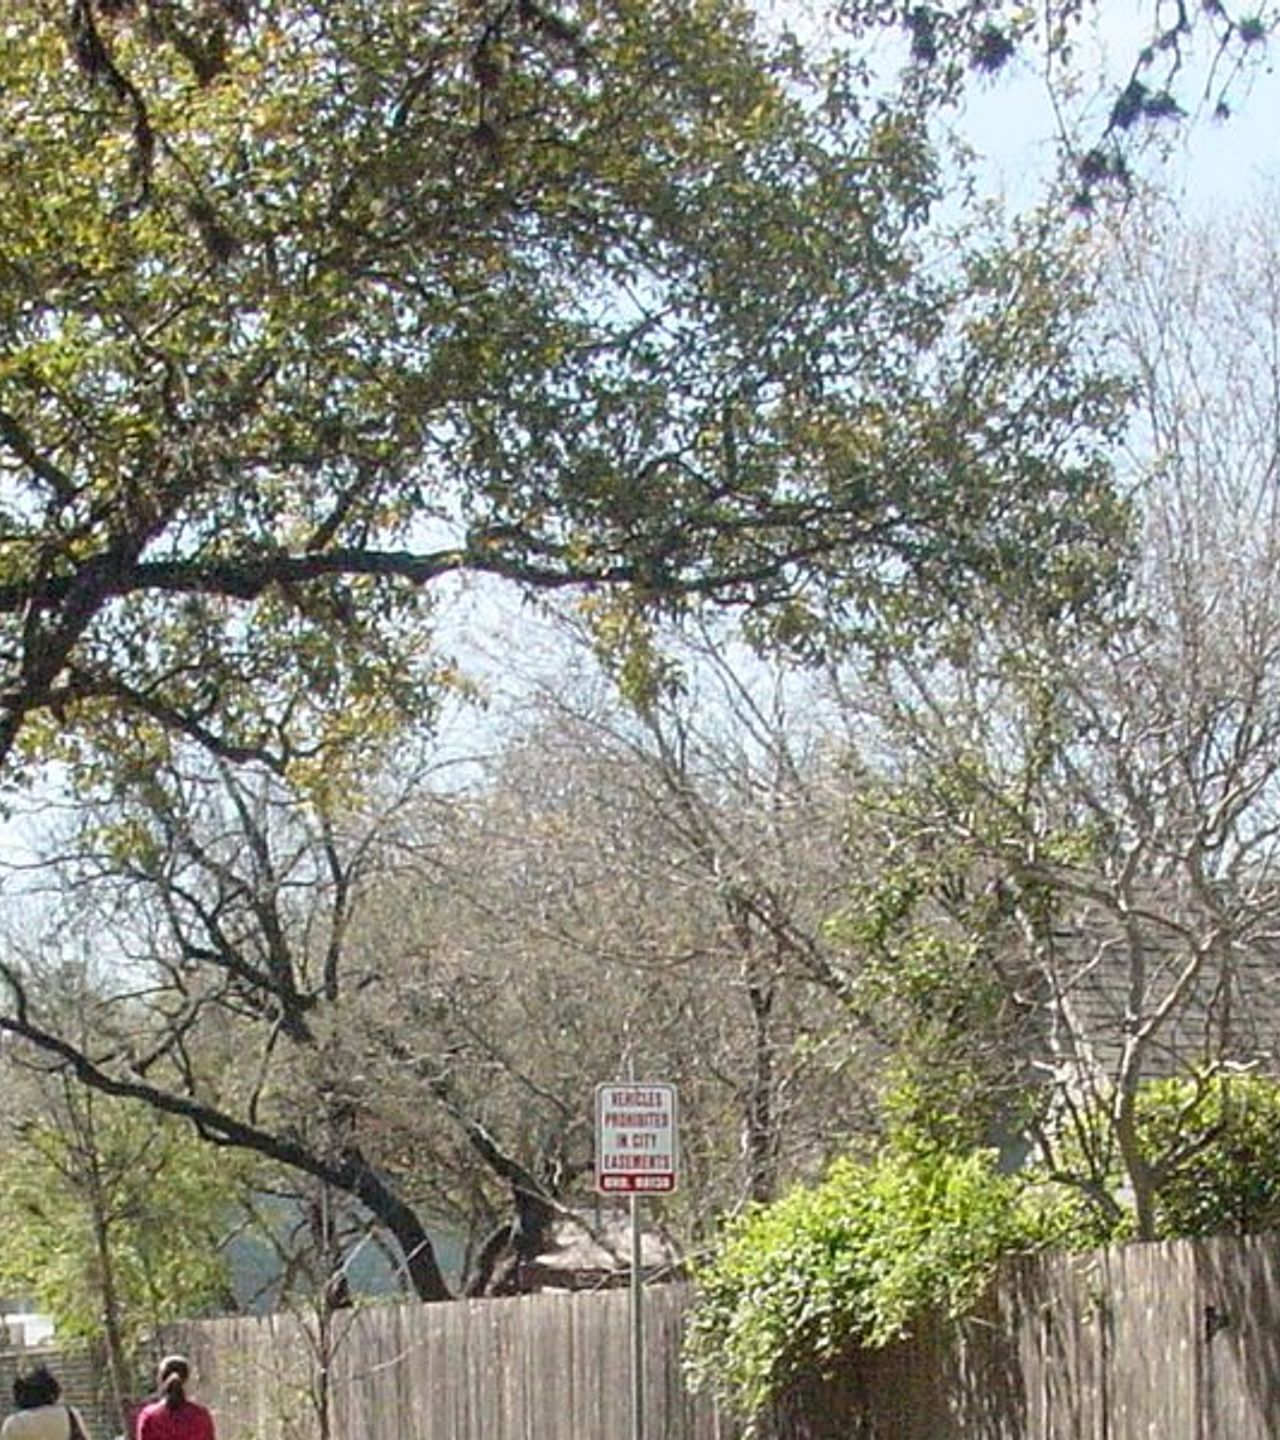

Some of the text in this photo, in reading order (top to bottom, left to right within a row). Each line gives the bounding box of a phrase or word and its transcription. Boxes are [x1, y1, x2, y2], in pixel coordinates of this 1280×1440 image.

[611, 1092, 662, 1107] VEHICLES
[604, 1113, 669, 1128] PROHIBITED
[616, 1134, 657, 1149] IN CITY
[604, 1155, 670, 1170] EASEMENTS
